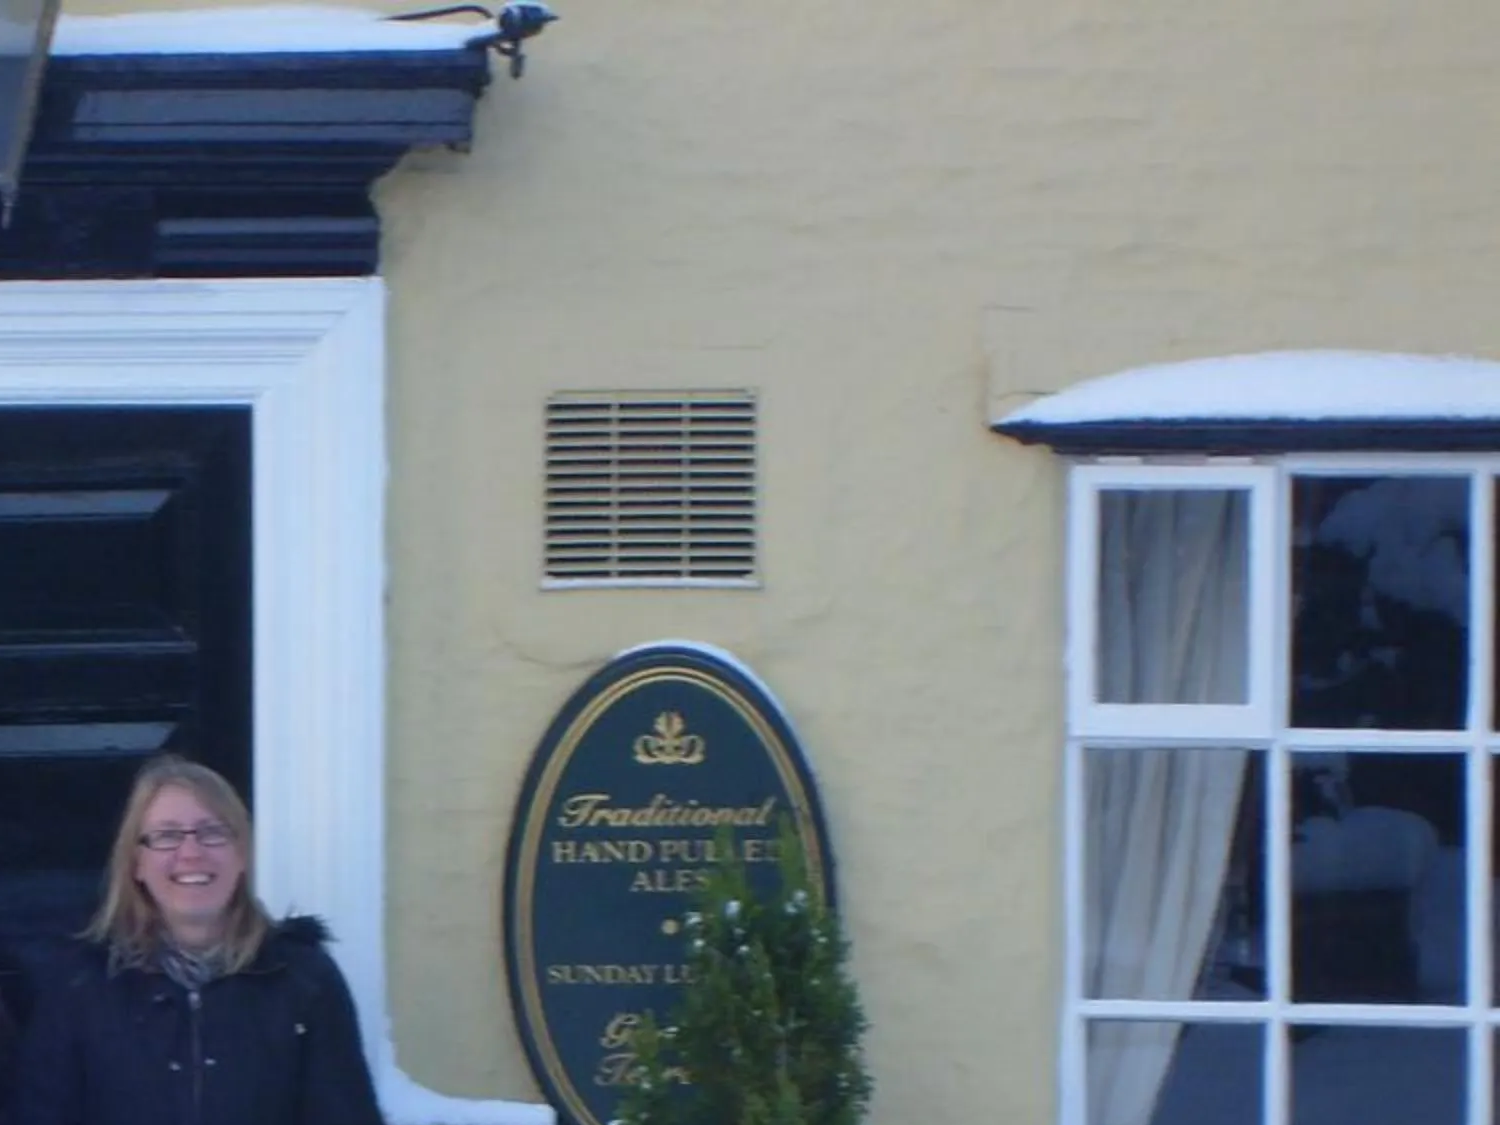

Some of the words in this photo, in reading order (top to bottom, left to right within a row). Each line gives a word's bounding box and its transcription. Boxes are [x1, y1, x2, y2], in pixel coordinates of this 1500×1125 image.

[557, 793, 777, 827] Traditional
[552, 840, 653, 863] HAND
[548, 964, 658, 985] SUNDAY
